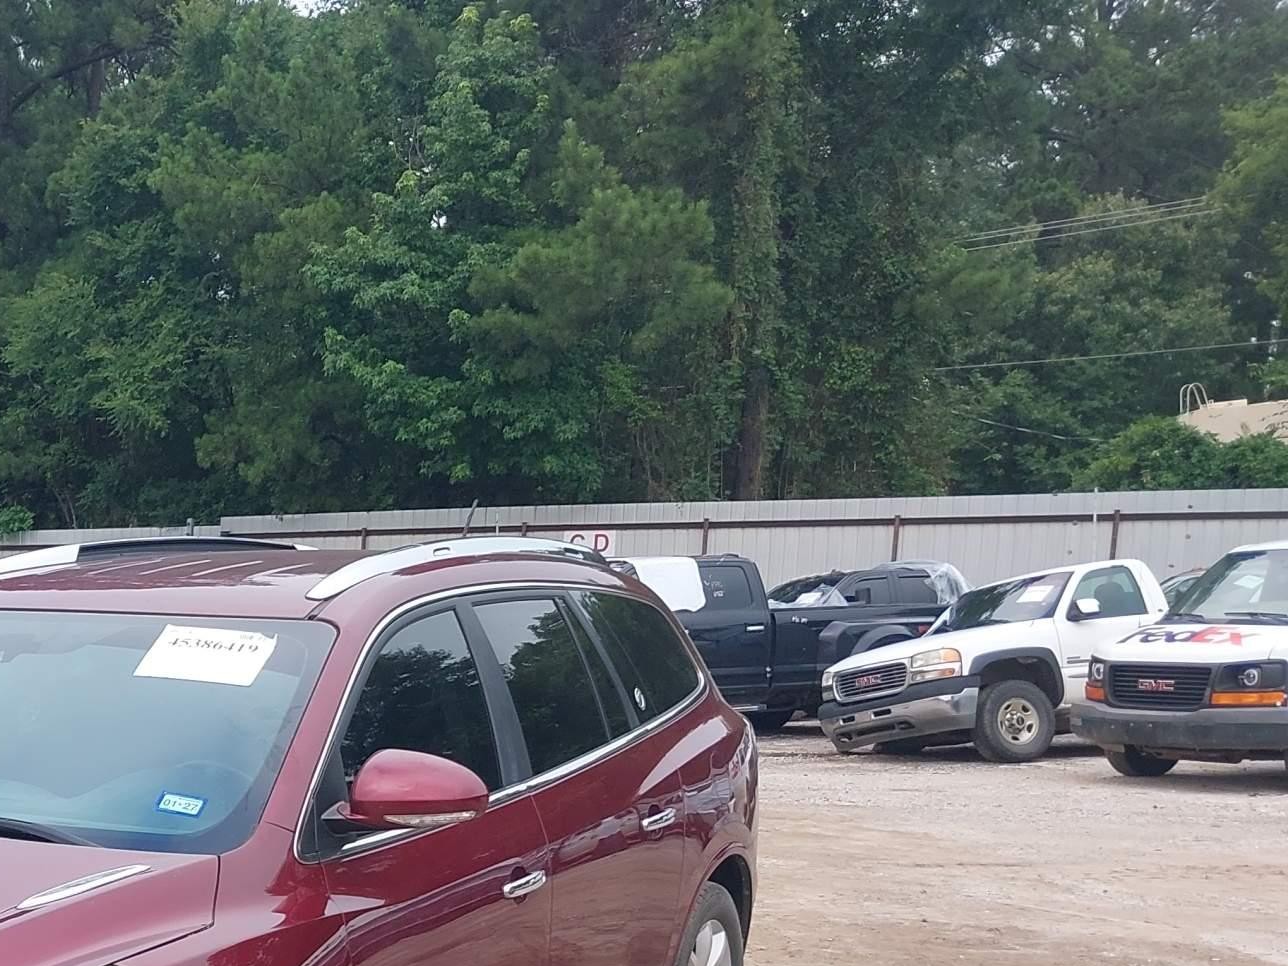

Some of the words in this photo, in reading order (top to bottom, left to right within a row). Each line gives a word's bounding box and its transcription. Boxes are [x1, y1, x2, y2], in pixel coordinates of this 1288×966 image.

[594, 534, 609, 552] D
[1116, 626, 1261, 646] FedEx
[1138, 679, 1175, 691] GMC
